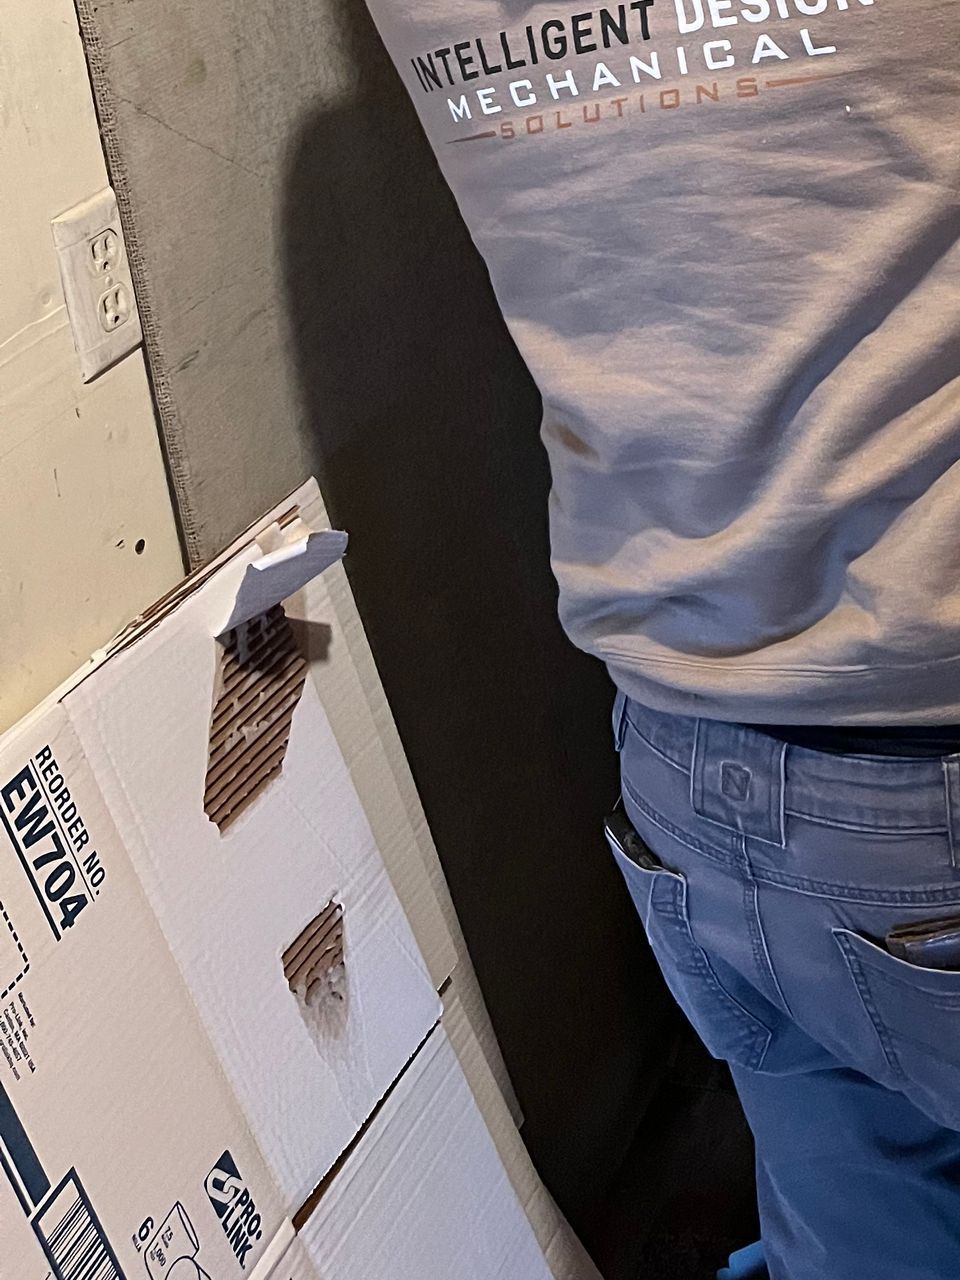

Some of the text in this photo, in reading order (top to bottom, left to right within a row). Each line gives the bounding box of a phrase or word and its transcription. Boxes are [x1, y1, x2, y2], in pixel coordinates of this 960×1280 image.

[447, 29, 837, 123] MECHANICAL
[500, 77, 761, 140] SOLUTIONS
[1, 764, 89, 931] EW704
[35, 744, 106, 896] REORDER NO.
[138, 1216, 154, 1242] 6
